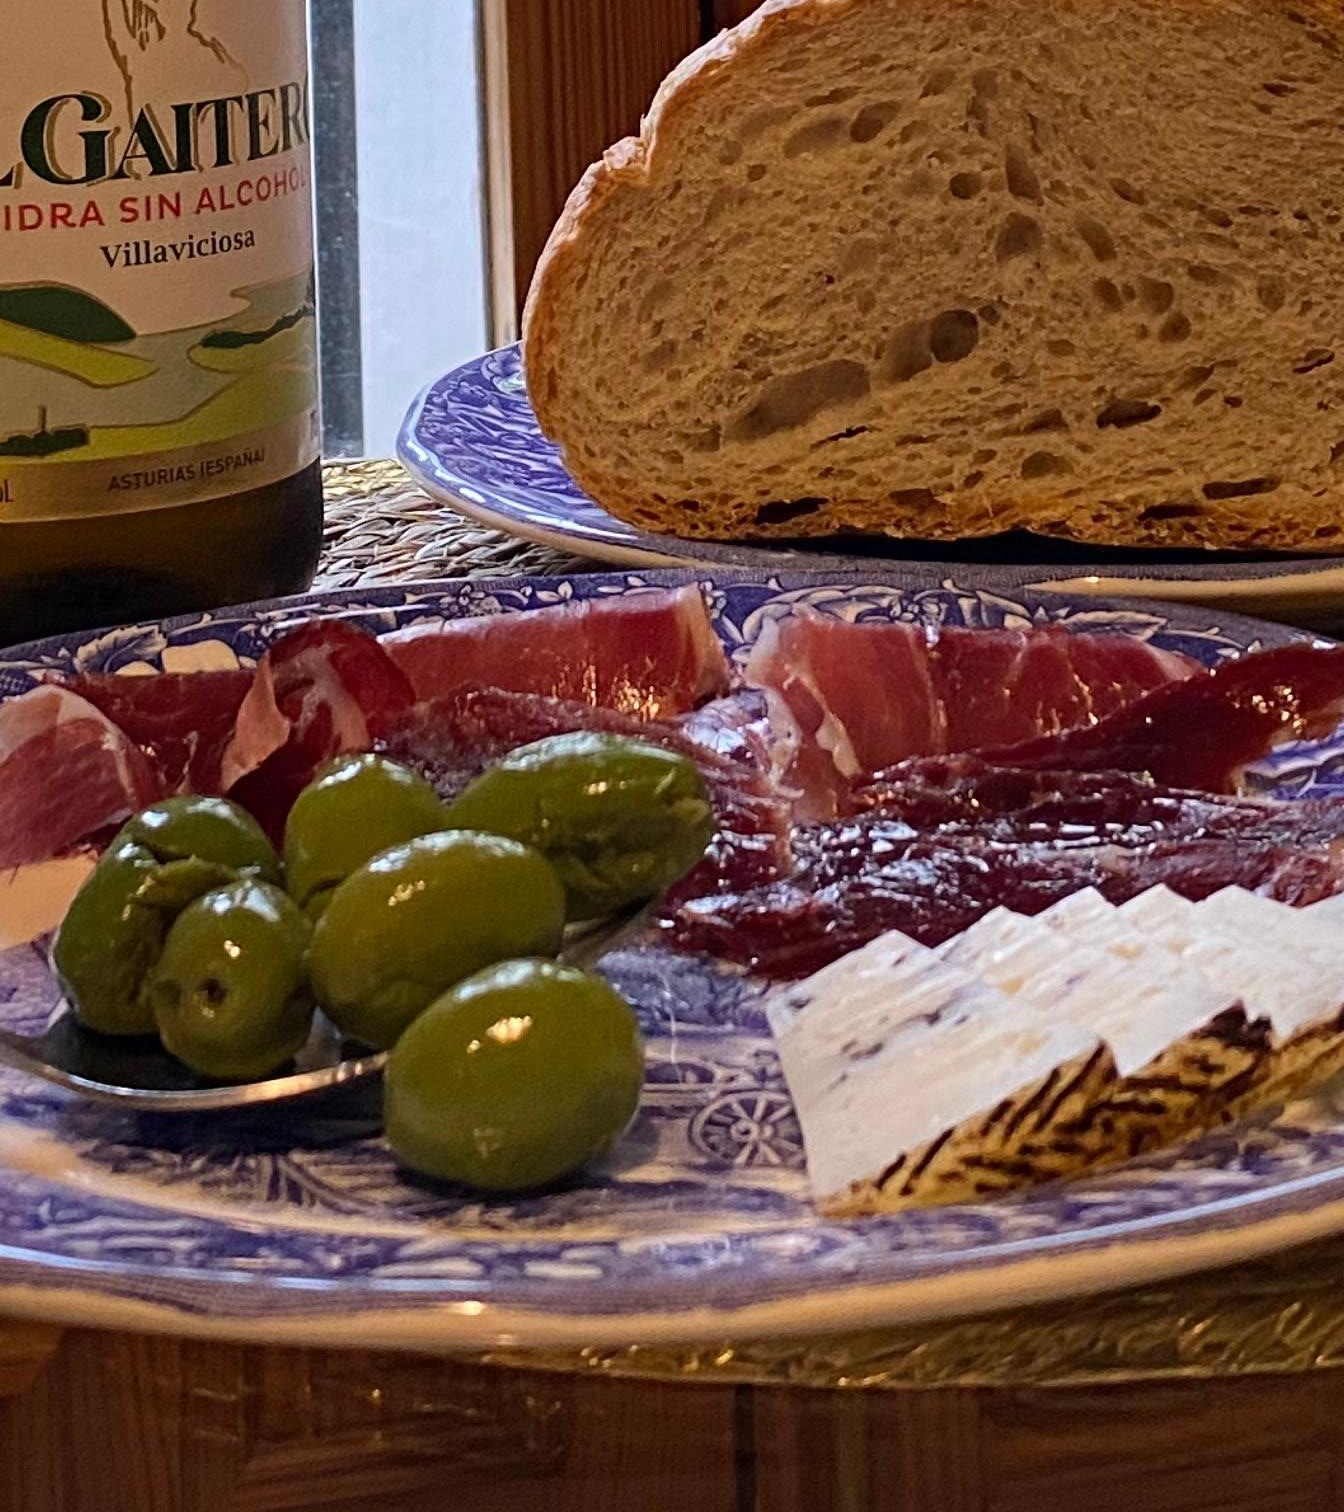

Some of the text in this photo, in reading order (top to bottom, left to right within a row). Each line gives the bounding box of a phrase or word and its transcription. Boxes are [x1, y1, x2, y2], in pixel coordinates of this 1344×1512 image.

[119, 191, 182, 223] SIN
[99, 228, 256, 269] Villaviciosa
[108, 462, 196, 492] ASTURIAS
